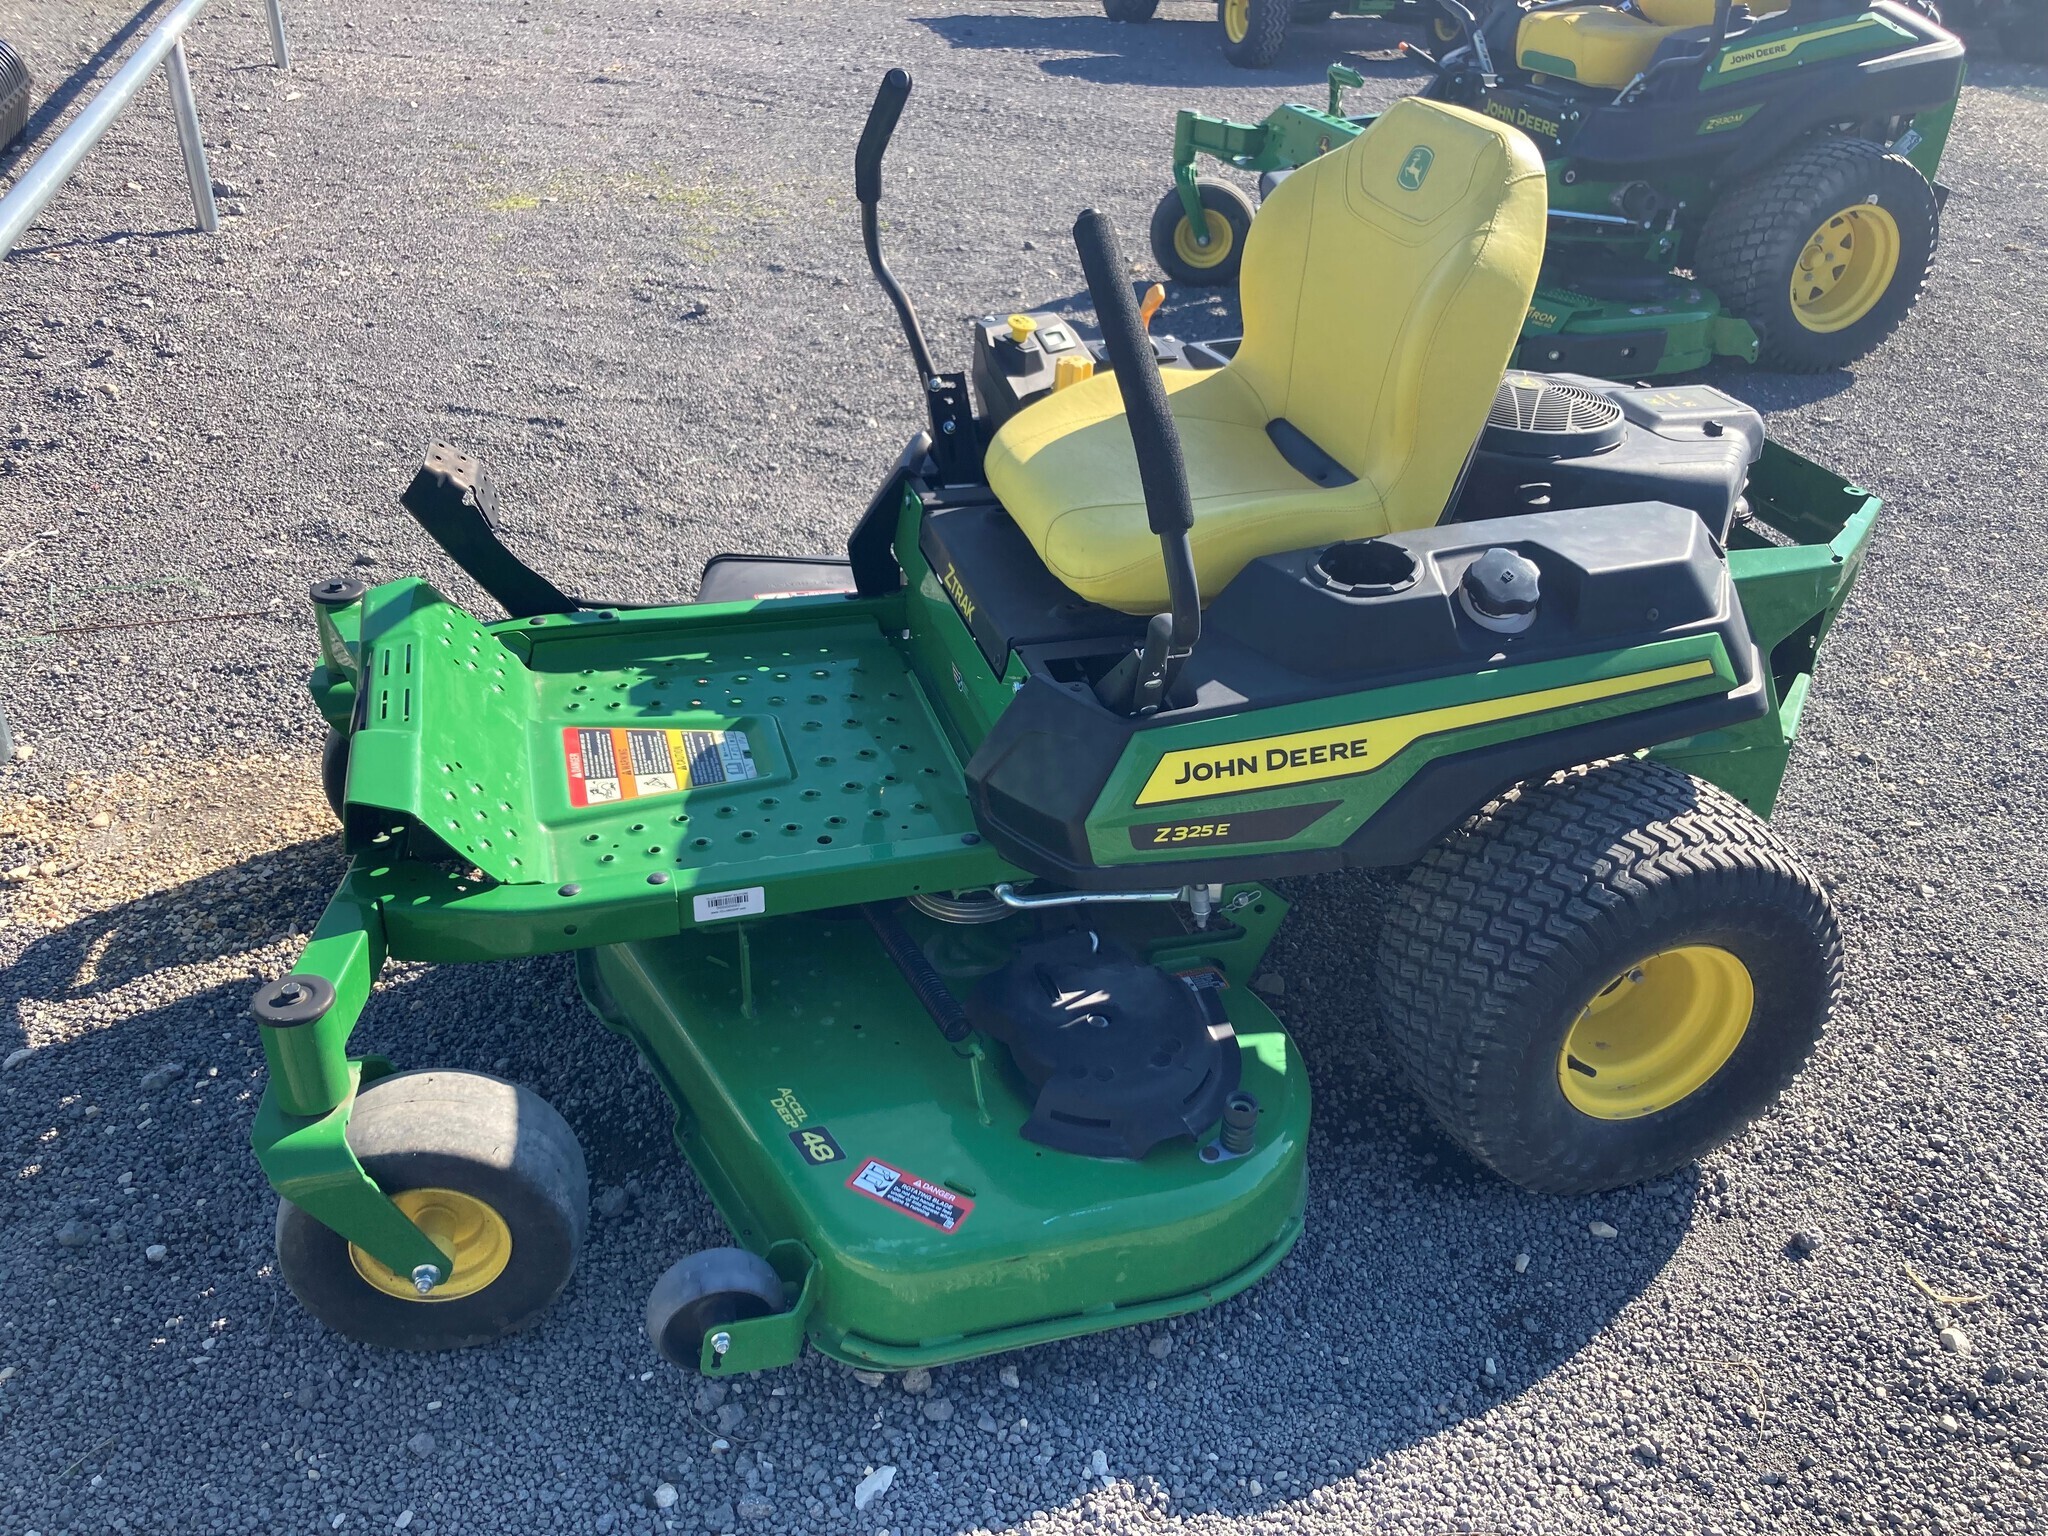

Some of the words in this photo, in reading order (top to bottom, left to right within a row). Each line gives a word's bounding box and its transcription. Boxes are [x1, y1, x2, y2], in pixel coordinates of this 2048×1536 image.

[1730, 53, 1755, 65] JOHN
[1756, 44, 1787, 58] DEERE
[1483, 98, 1515, 123] JOHN
[1517, 107, 1559, 138] DEERE
[943, 561, 976, 623] ZTRAK
[1174, 756, 1258, 785] JOHN
[1266, 738, 1368, 771] DEERE
[770, 1098, 799, 1128] DEEP
[777, 1088, 808, 1123] ACCEL
[802, 1132, 835, 1162] 48
[901, 1184, 932, 1200] ROTATING
[932, 1196, 953, 1210] BLADE
[922, 1183, 956, 1201] DANGER
